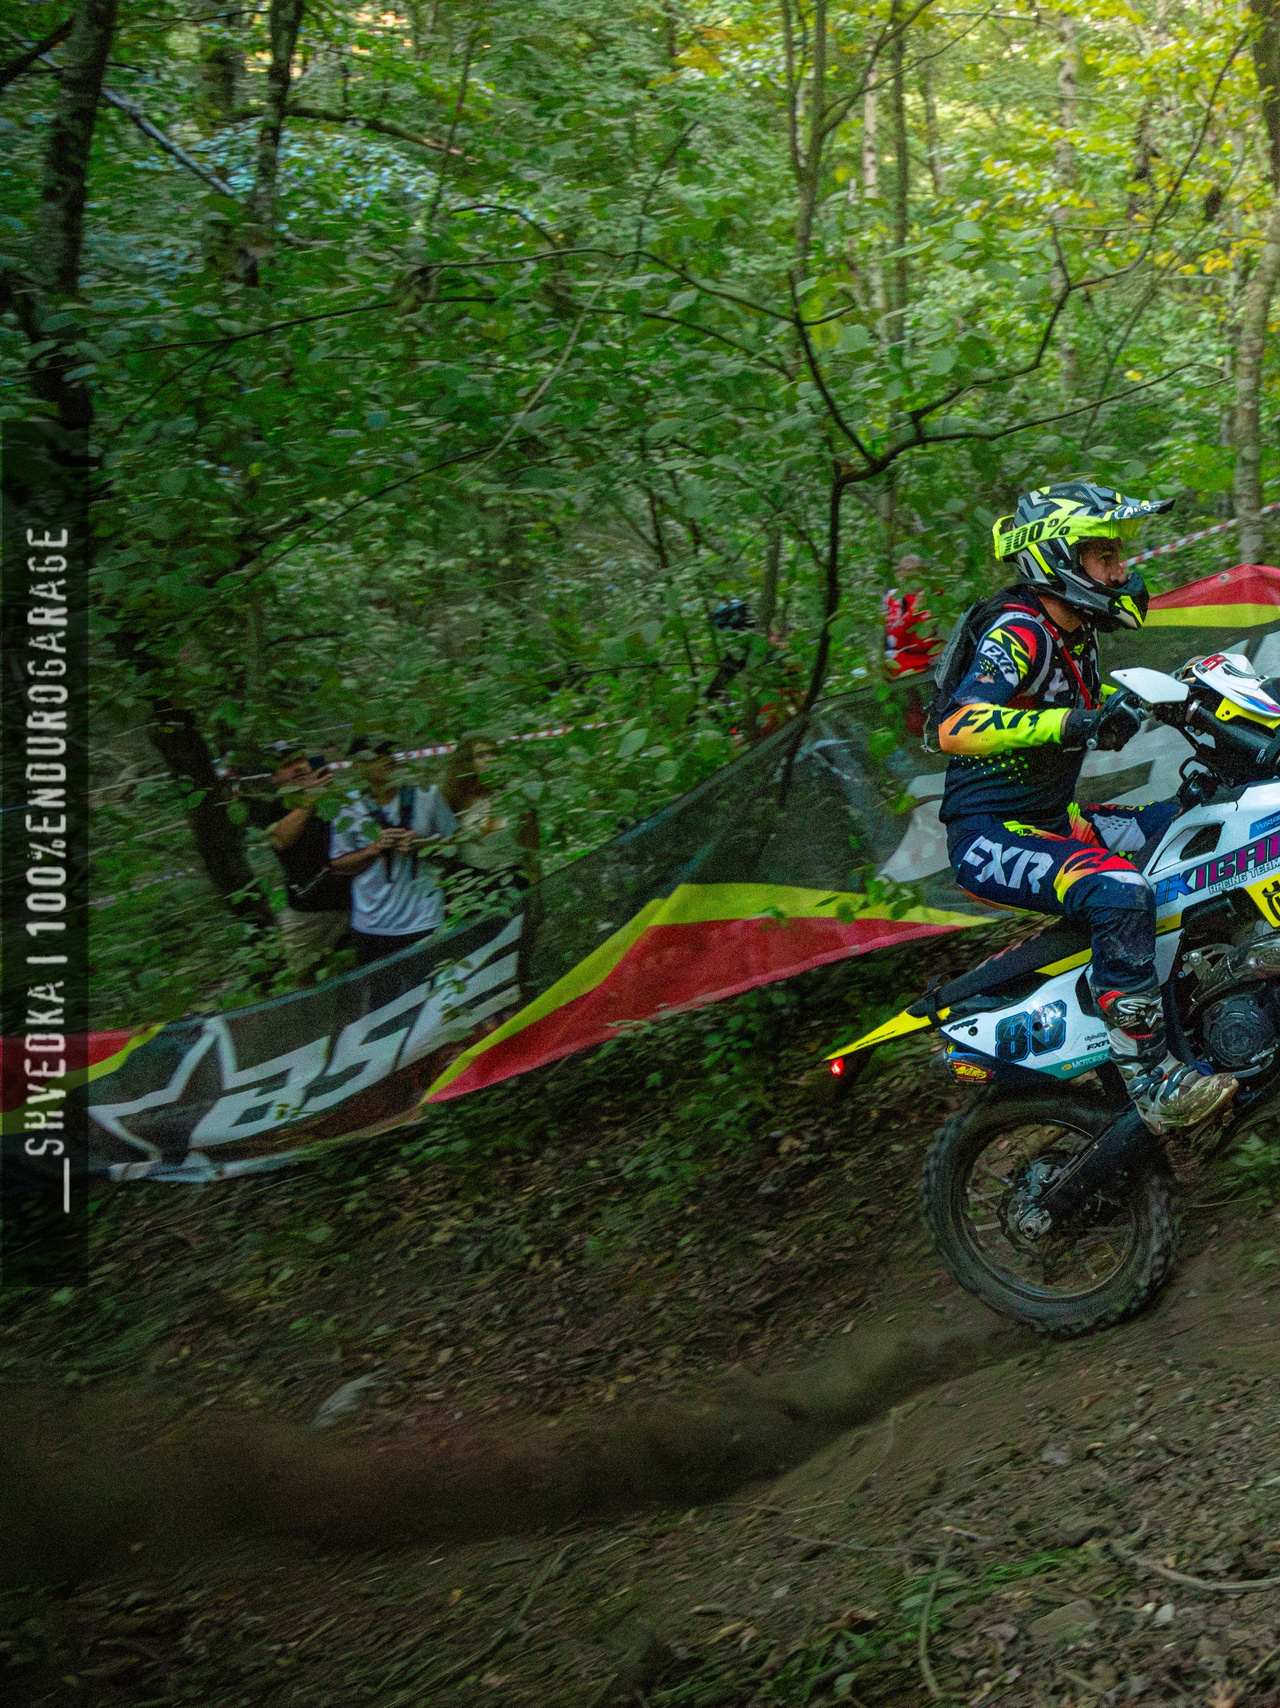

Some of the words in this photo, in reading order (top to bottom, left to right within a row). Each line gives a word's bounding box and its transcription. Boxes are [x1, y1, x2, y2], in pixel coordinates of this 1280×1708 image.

[1003, 516, 1072, 554] 100%
[948, 707, 1046, 736] FXR
[961, 834, 1055, 895] FXR
[1207, 872, 1248, 895] RACING
[1071, 1052, 1109, 1069] MOTOREX
